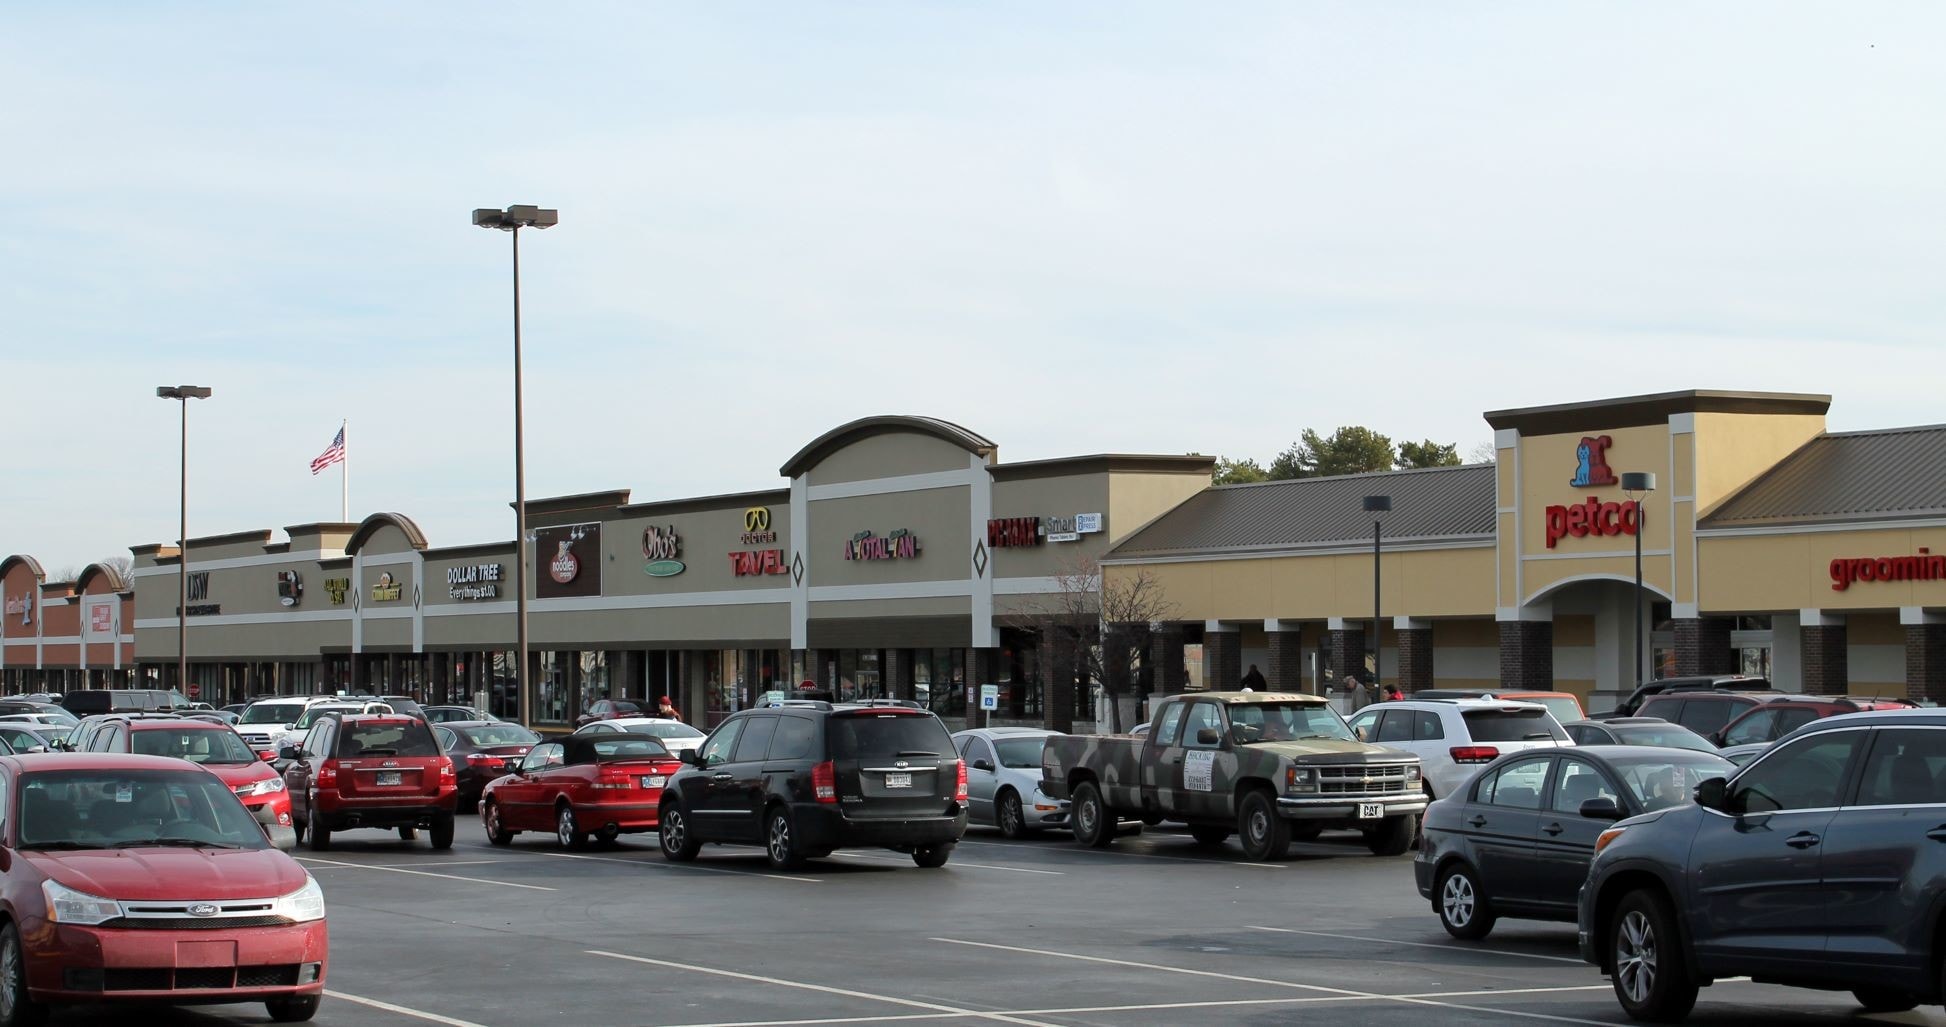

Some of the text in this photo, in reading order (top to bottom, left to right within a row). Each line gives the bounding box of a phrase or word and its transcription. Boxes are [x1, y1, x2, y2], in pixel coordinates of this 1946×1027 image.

[1546, 496, 1645, 549] petco
[740, 532, 776, 544] DOCTOR
[845, 539, 854, 560] A
[552, 556, 575, 571] noodles
[728, 549, 788, 576] TAVEL
[1829, 547, 1946, 592] groomin
[447, 563, 499, 583] DOLLAR TREE
[1364, 806, 1378, 816] CAT
[195, 905, 214, 913] Ford
